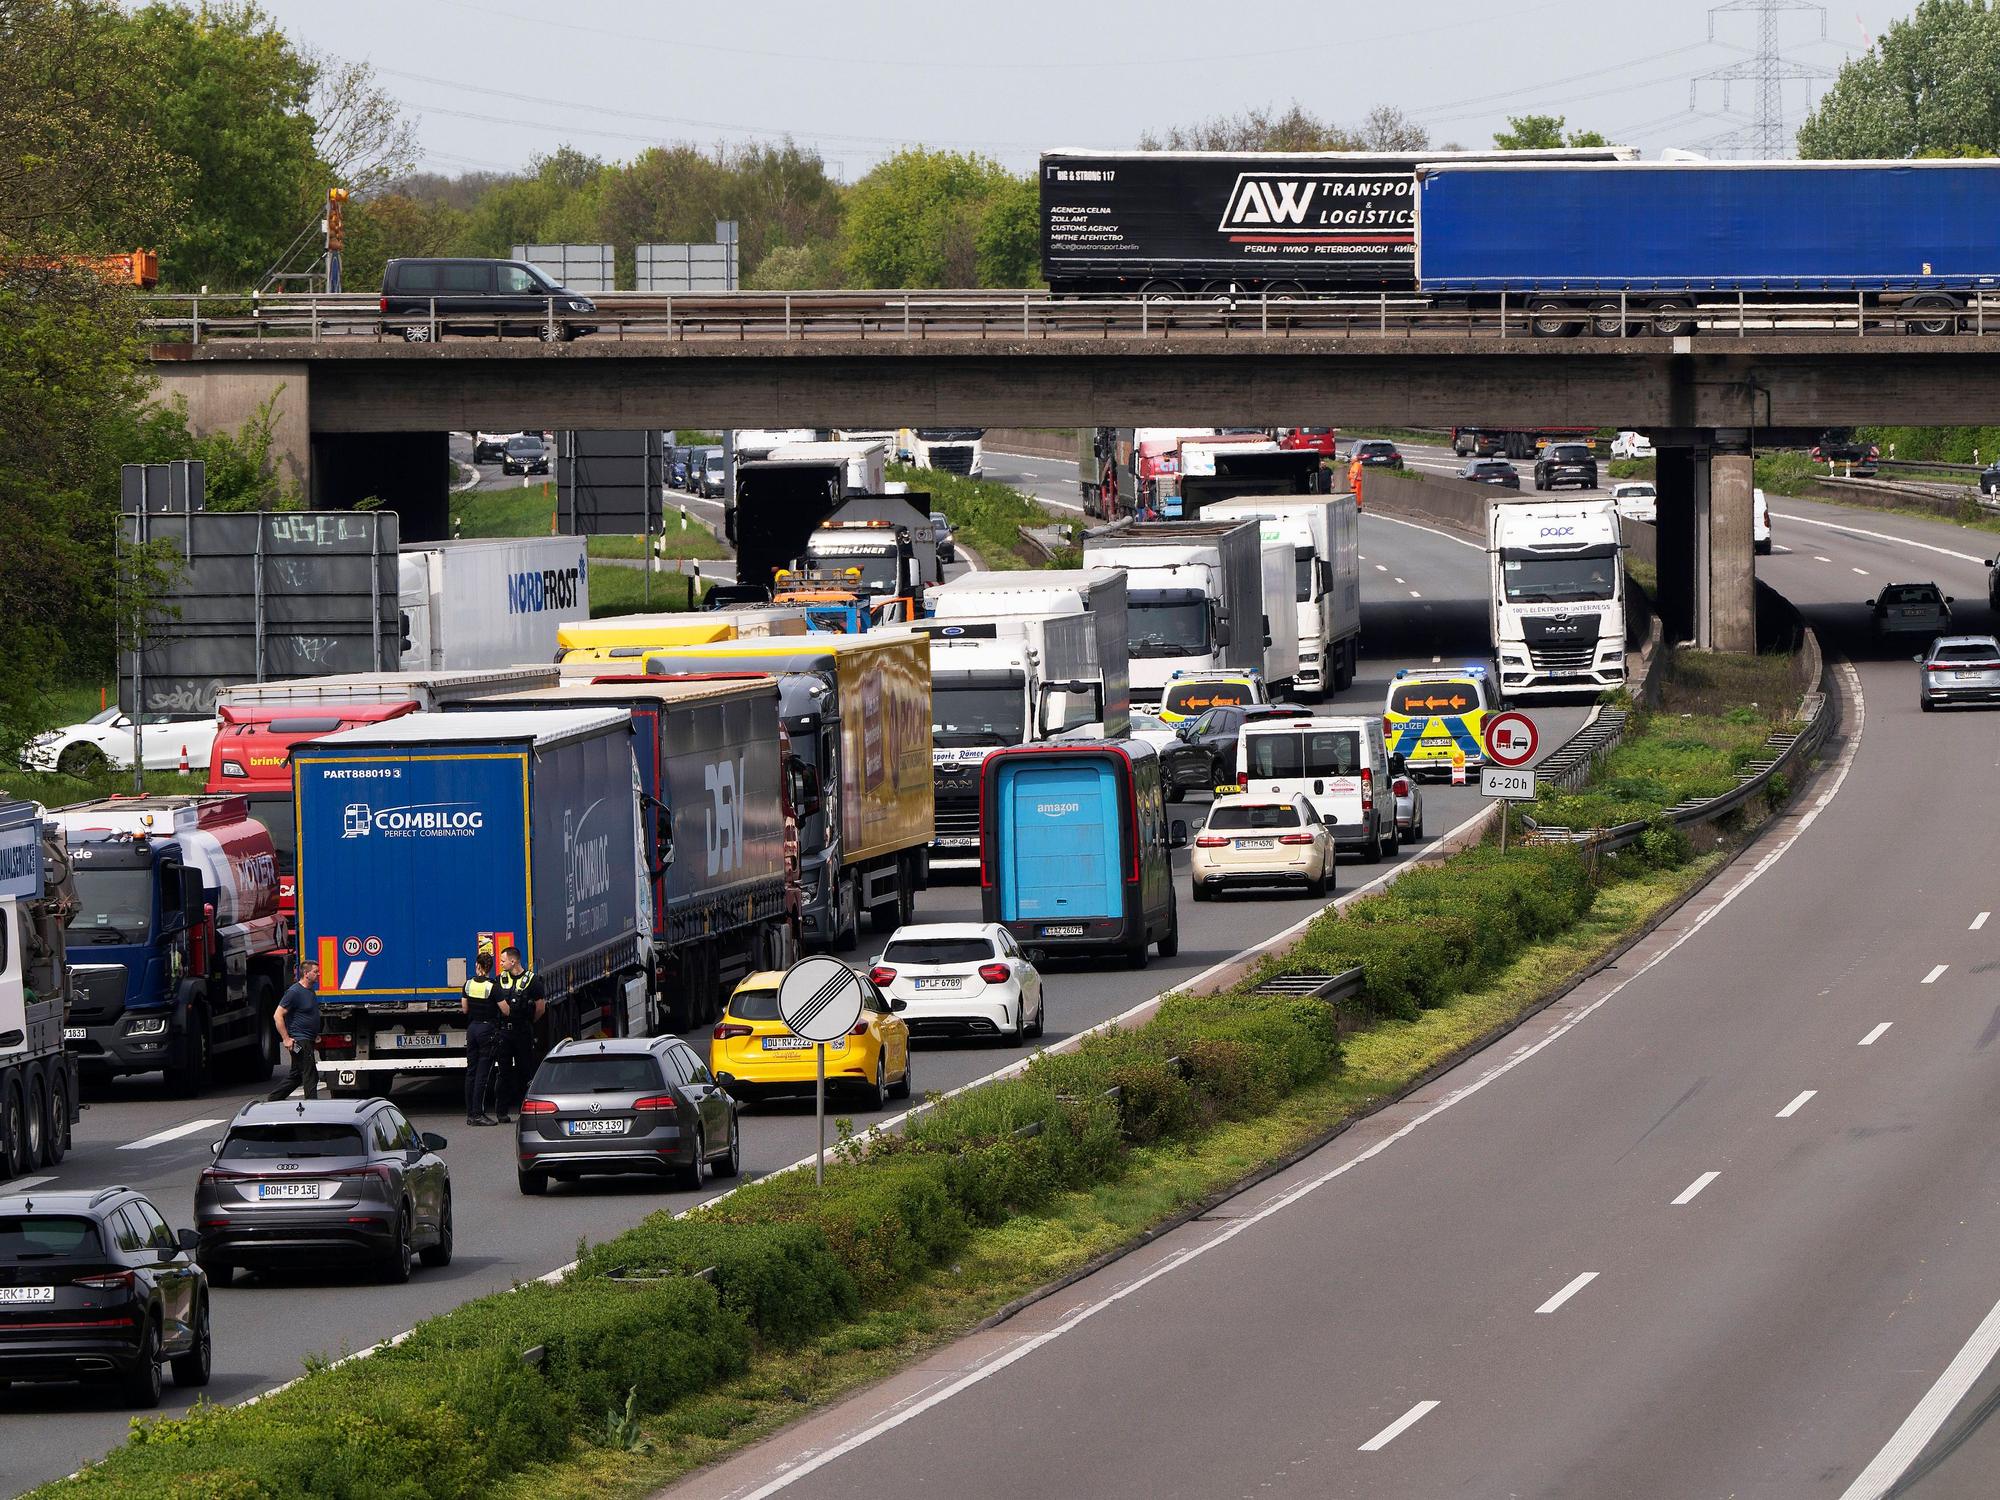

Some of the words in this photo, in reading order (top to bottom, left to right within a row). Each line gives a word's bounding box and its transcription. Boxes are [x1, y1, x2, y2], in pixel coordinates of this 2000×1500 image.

[1075, 171, 1101, 181] STRONG
[1103, 171, 1115, 181] 117
[1232, 182, 1317, 224] AW
[1051, 243, 1139, 251] office@awtransport.berlin
[1283, 245, 1309, 253] IWNO
[1314, 245, 1388, 253] PETERBOROUGH
[508, 568, 578, 614] NORDFROST
[1570, 604, 1611, 612] UNTERWEGS
[1545, 626, 1578, 634] MAN
[1392, 721, 1425, 730] POLIZEI
[323, 769, 391, 779] PART888019
[1037, 803, 1079, 815] amazon
[375, 811, 483, 829] COMBILOG
[384, 830, 416, 838] PERFECT
[420, 829, 475, 837] COMBINATION
[574, 833, 610, 902] COMBILOG
[348, 942, 357, 951] 70
[368, 941, 378, 950] 80
[921, 979, 927, 988] D
[930, 979, 939, 988] LF
[941, 978, 961, 987] 6789
[68, 1029, 85, 1038] 1831
[768, 1038, 777, 1047] DU
[782, 1038, 792, 1046] RW
[341, 1073, 354, 1082] TIP
[574, 1121, 587, 1131] MO
[593, 1120, 604, 1130] RS
[606, 1120, 622, 1129] 139
[265, 1186, 282, 1195] BOH
[288, 1186, 299, 1195] EP
[301, 1185, 317, 1195] 13E
[27, 1288, 40, 1299] IP
[44, 1287, 50, 1298] 2
